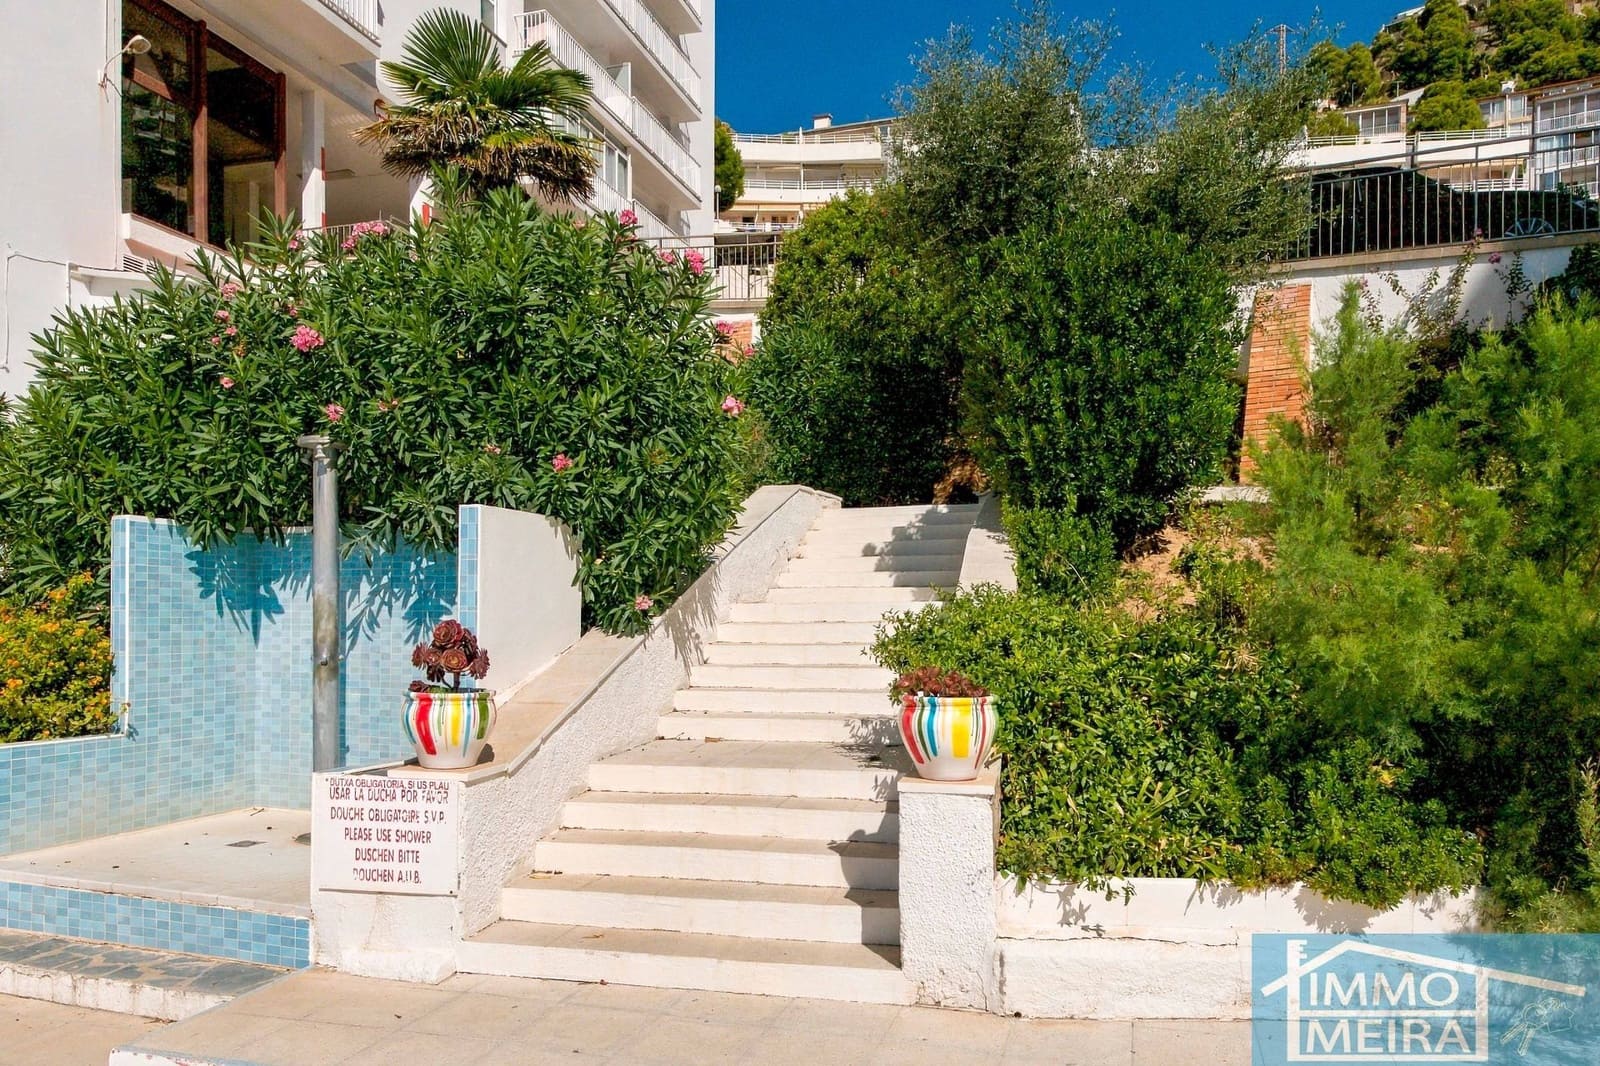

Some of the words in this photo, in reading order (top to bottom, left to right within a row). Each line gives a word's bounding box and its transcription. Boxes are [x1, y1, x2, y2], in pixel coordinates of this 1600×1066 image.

[408, 781, 415, 789] SI
[417, 781, 427, 790] US
[429, 781, 449, 790] PLAU
[329, 787, 350, 800] USAR
[354, 788, 364, 800] LA
[367, 789, 396, 801] DUCHA
[401, 790, 418, 803] POR
[421, 791, 449, 804] FAVOR
[330, 807, 364, 821] DOUCHE
[368, 808, 420, 823] OBLIGATOIRE
[424, 810, 446, 824] SV.P.
[345, 828, 372, 841] PLEASE
[376, 829, 392, 842] USE
[396, 830, 432, 843] SHOWER
[355, 848, 394, 862] DUSCHEN
[398, 850, 420, 863] BITTE
[353, 868, 394, 882] DOUCHEN
[397, 871, 421, 884] A.UB.
